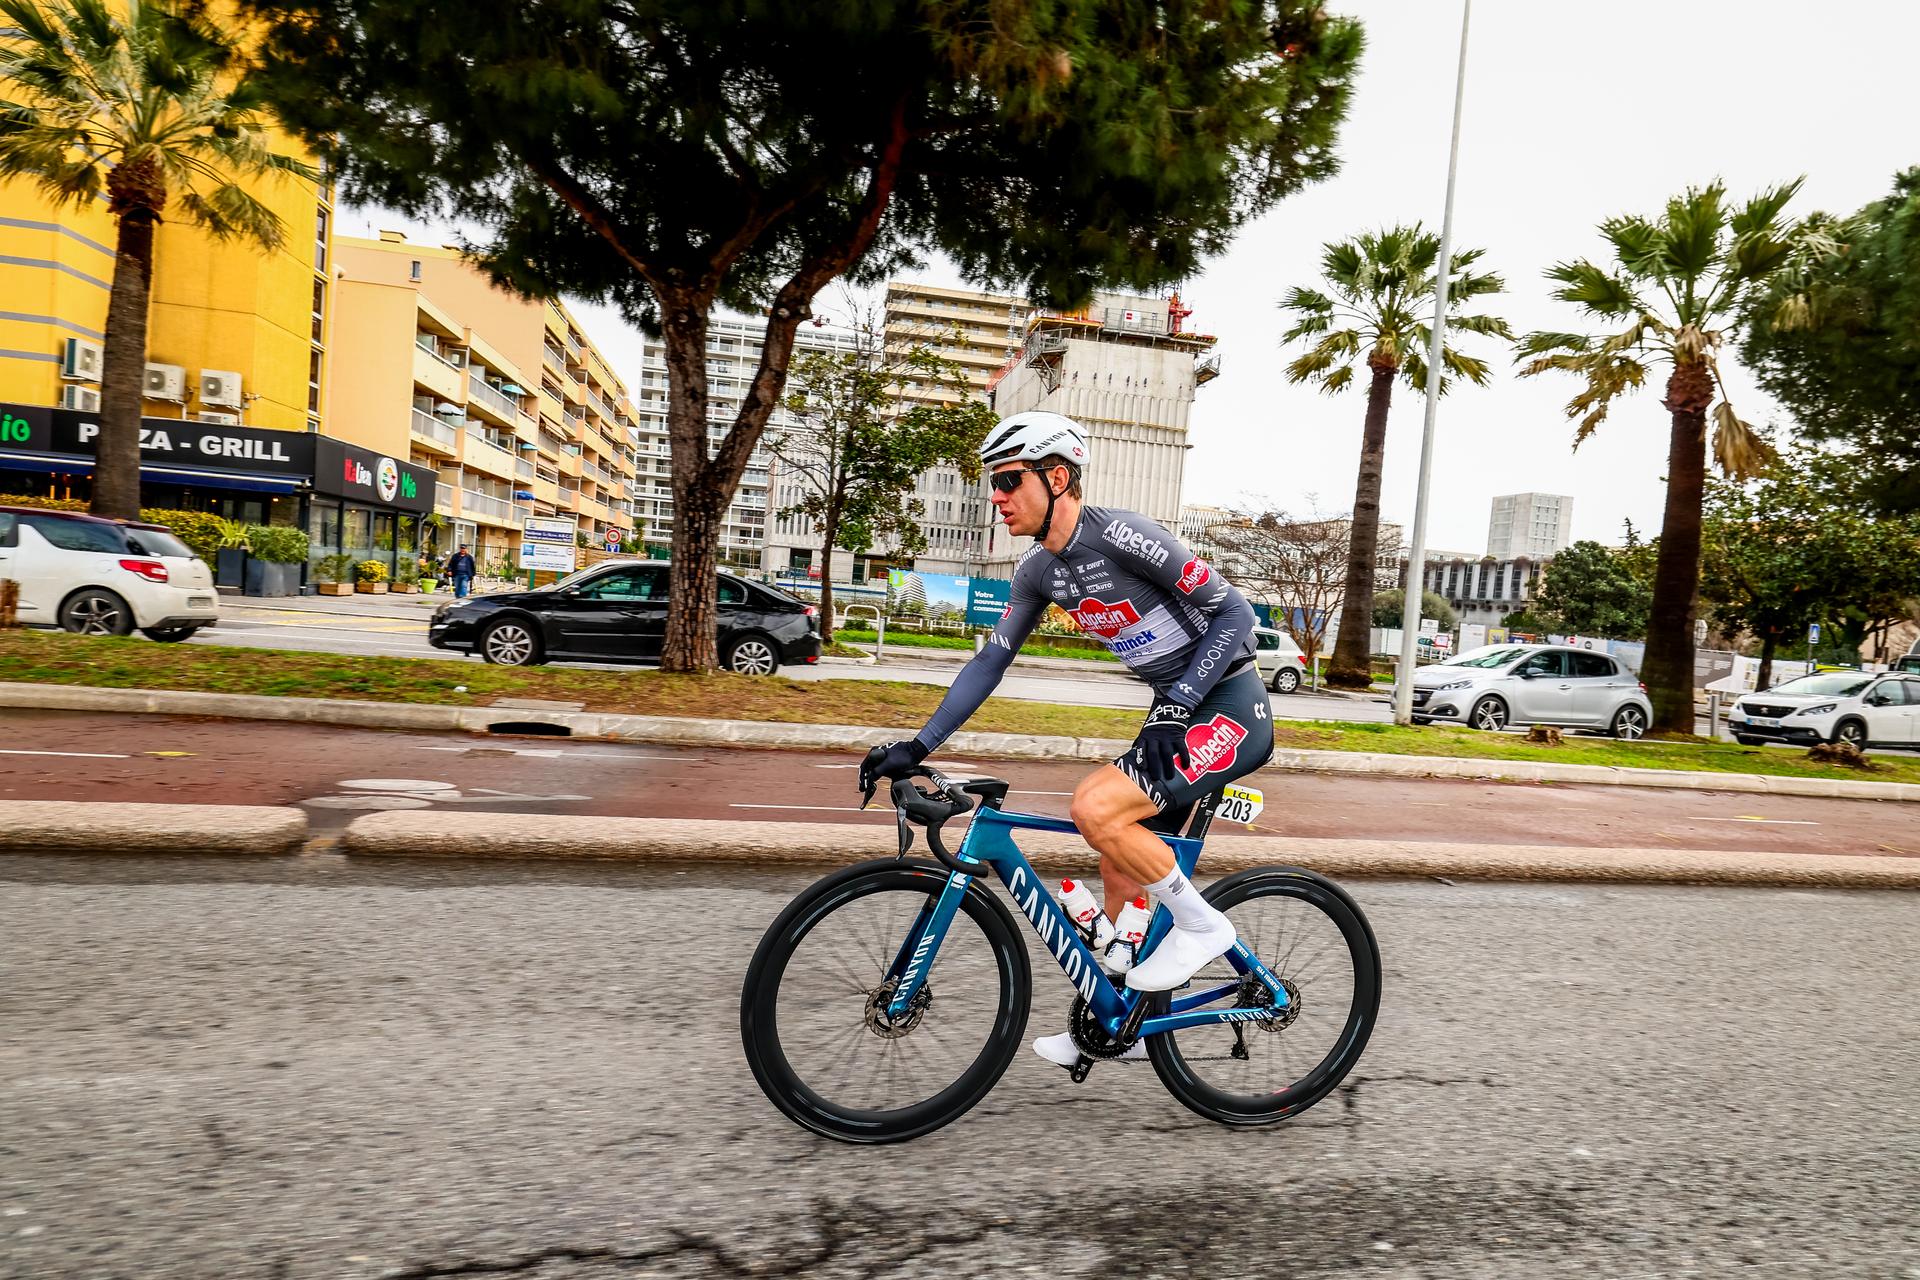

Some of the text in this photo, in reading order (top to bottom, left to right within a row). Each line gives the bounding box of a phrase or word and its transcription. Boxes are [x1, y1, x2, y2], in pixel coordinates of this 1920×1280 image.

[0, 409, 31, 442] io
[78, 422, 173, 451] PZA
[199, 435, 291, 462] GRILL
[1029, 430, 1067, 454] CANYON
[401, 471, 417, 499] Mio
[1104, 520, 1169, 563] Alpecin
[1118, 543, 1163, 568] BOOSTER
[974, 590, 994, 599] Votre
[1077, 607, 1127, 630] Alpecin
[1189, 723, 1236, 773] Alpecin
[1195, 734, 1241, 777] HAIR BOOSTER
[1232, 790, 1253, 801] LCL
[1221, 799, 1253, 823] 203
[1009, 867, 1097, 1003] CANYON
[892, 934, 936, 1002] CANYON
[1218, 1009, 1274, 1023] CANYON
